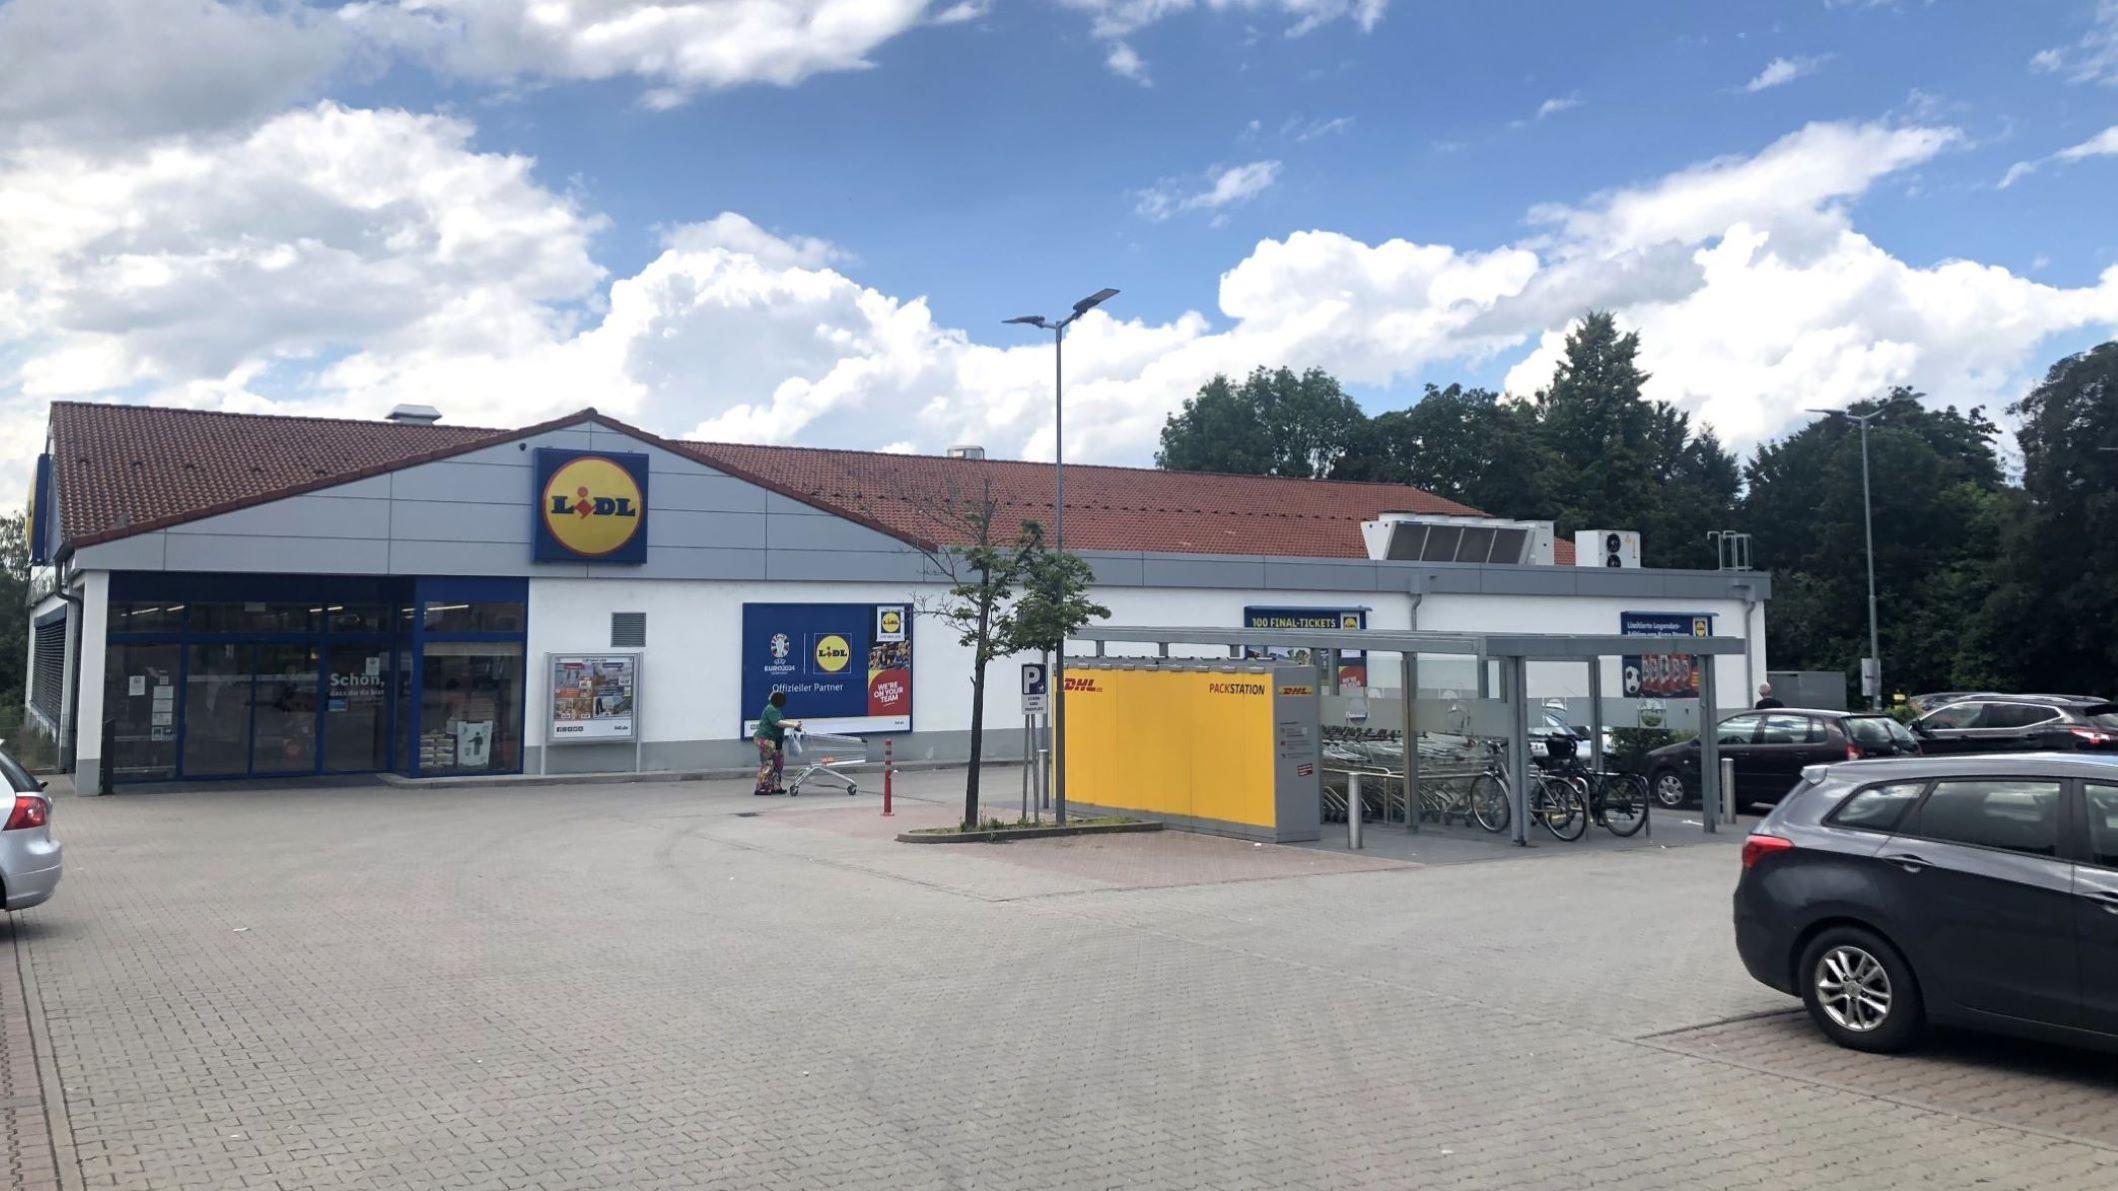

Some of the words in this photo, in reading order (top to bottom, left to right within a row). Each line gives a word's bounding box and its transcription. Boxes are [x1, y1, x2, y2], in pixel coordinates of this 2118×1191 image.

[1252, 617, 1269, 628] 100
[1270, 618, 1337, 628] FINAL-TICKETS
[878, 681, 898, 690] WE'RE
[1023, 666, 1040, 694] P
[1064, 678, 1096, 692] DHL
[772, 683, 812, 692] Offizieller
[813, 683, 843, 692] Partner
[874, 689, 885, 698] ON
[884, 686, 904, 696] YOUR
[1209, 683, 1265, 695] PACKSTATION
[880, 694, 899, 703] TEAM
